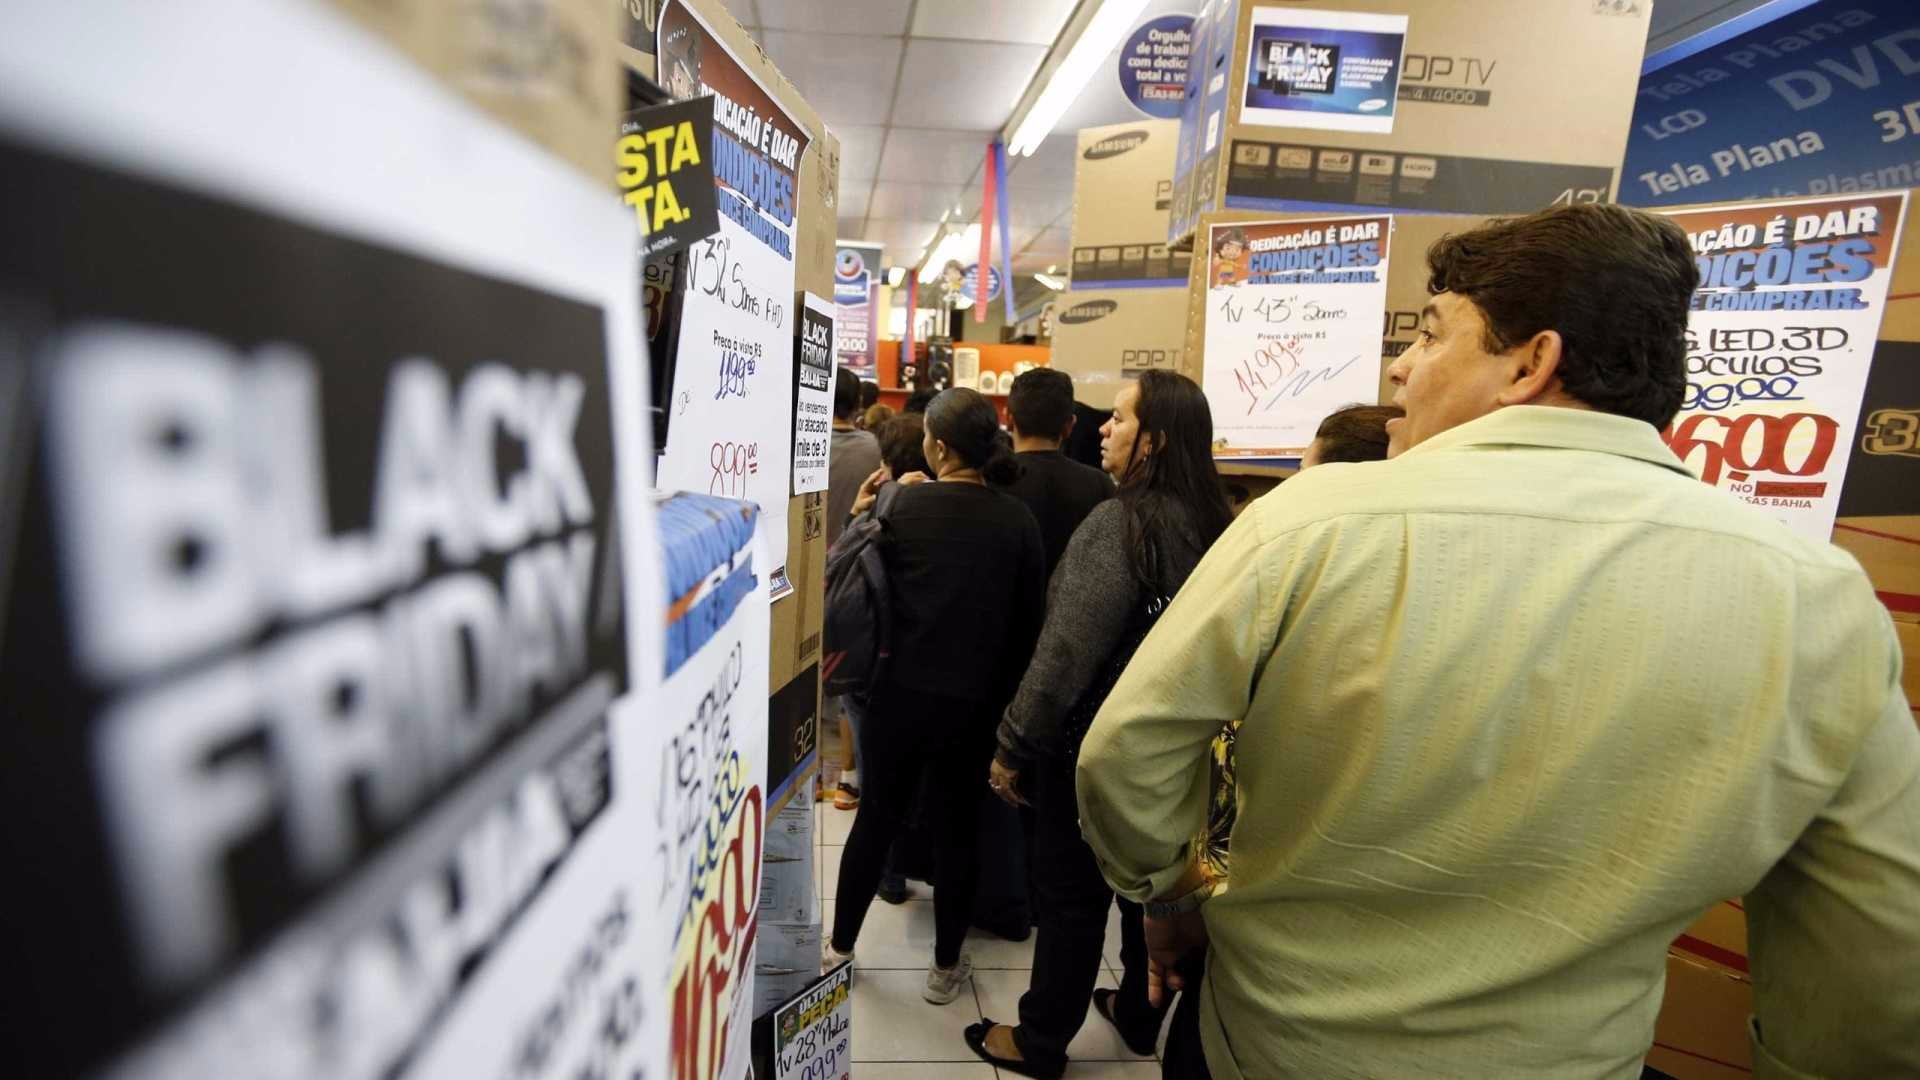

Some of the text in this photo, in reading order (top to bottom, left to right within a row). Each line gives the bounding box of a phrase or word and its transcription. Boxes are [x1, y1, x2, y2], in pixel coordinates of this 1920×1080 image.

[1128, 58, 1151, 67] com
[1136, 42, 1151, 54] de
[1269, 46, 1333, 66] BLACK
[1642, 8, 1878, 101] Tela Plana
[1136, 69, 1161, 81] total
[1266, 64, 1334, 83] FRIDAY
[1403, 54, 1496, 85] DP TV
[1643, 108, 1708, 140] LCD
[762, 117, 772, 153] É
[771, 129, 799, 171] DAR
[1639, 130, 1825, 196] Tela Plana
[1249, 222, 1380, 251] DEDICAÇÃO É DAR
[1763, 214, 1787, 245] É
[1794, 205, 1879, 241] DAR
[1249, 241, 1380, 273] CONDIÇÕES
[765, 297, 784, 329] FHD
[1706, 287, 1870, 312] COMPRAR.
[803, 318, 828, 347] BLACK
[801, 340, 828, 366] FRIDAY
[1121, 350, 1166, 367] PDP
[812, 438, 820, 456] de
[822, 439, 827, 457] 3
[1730, 483, 1753, 493] NO
[42, 322, 597, 690] BLACK
[1772, 497, 1812, 509] BAHIA
[95, 535, 602, 985] FRIDAY
